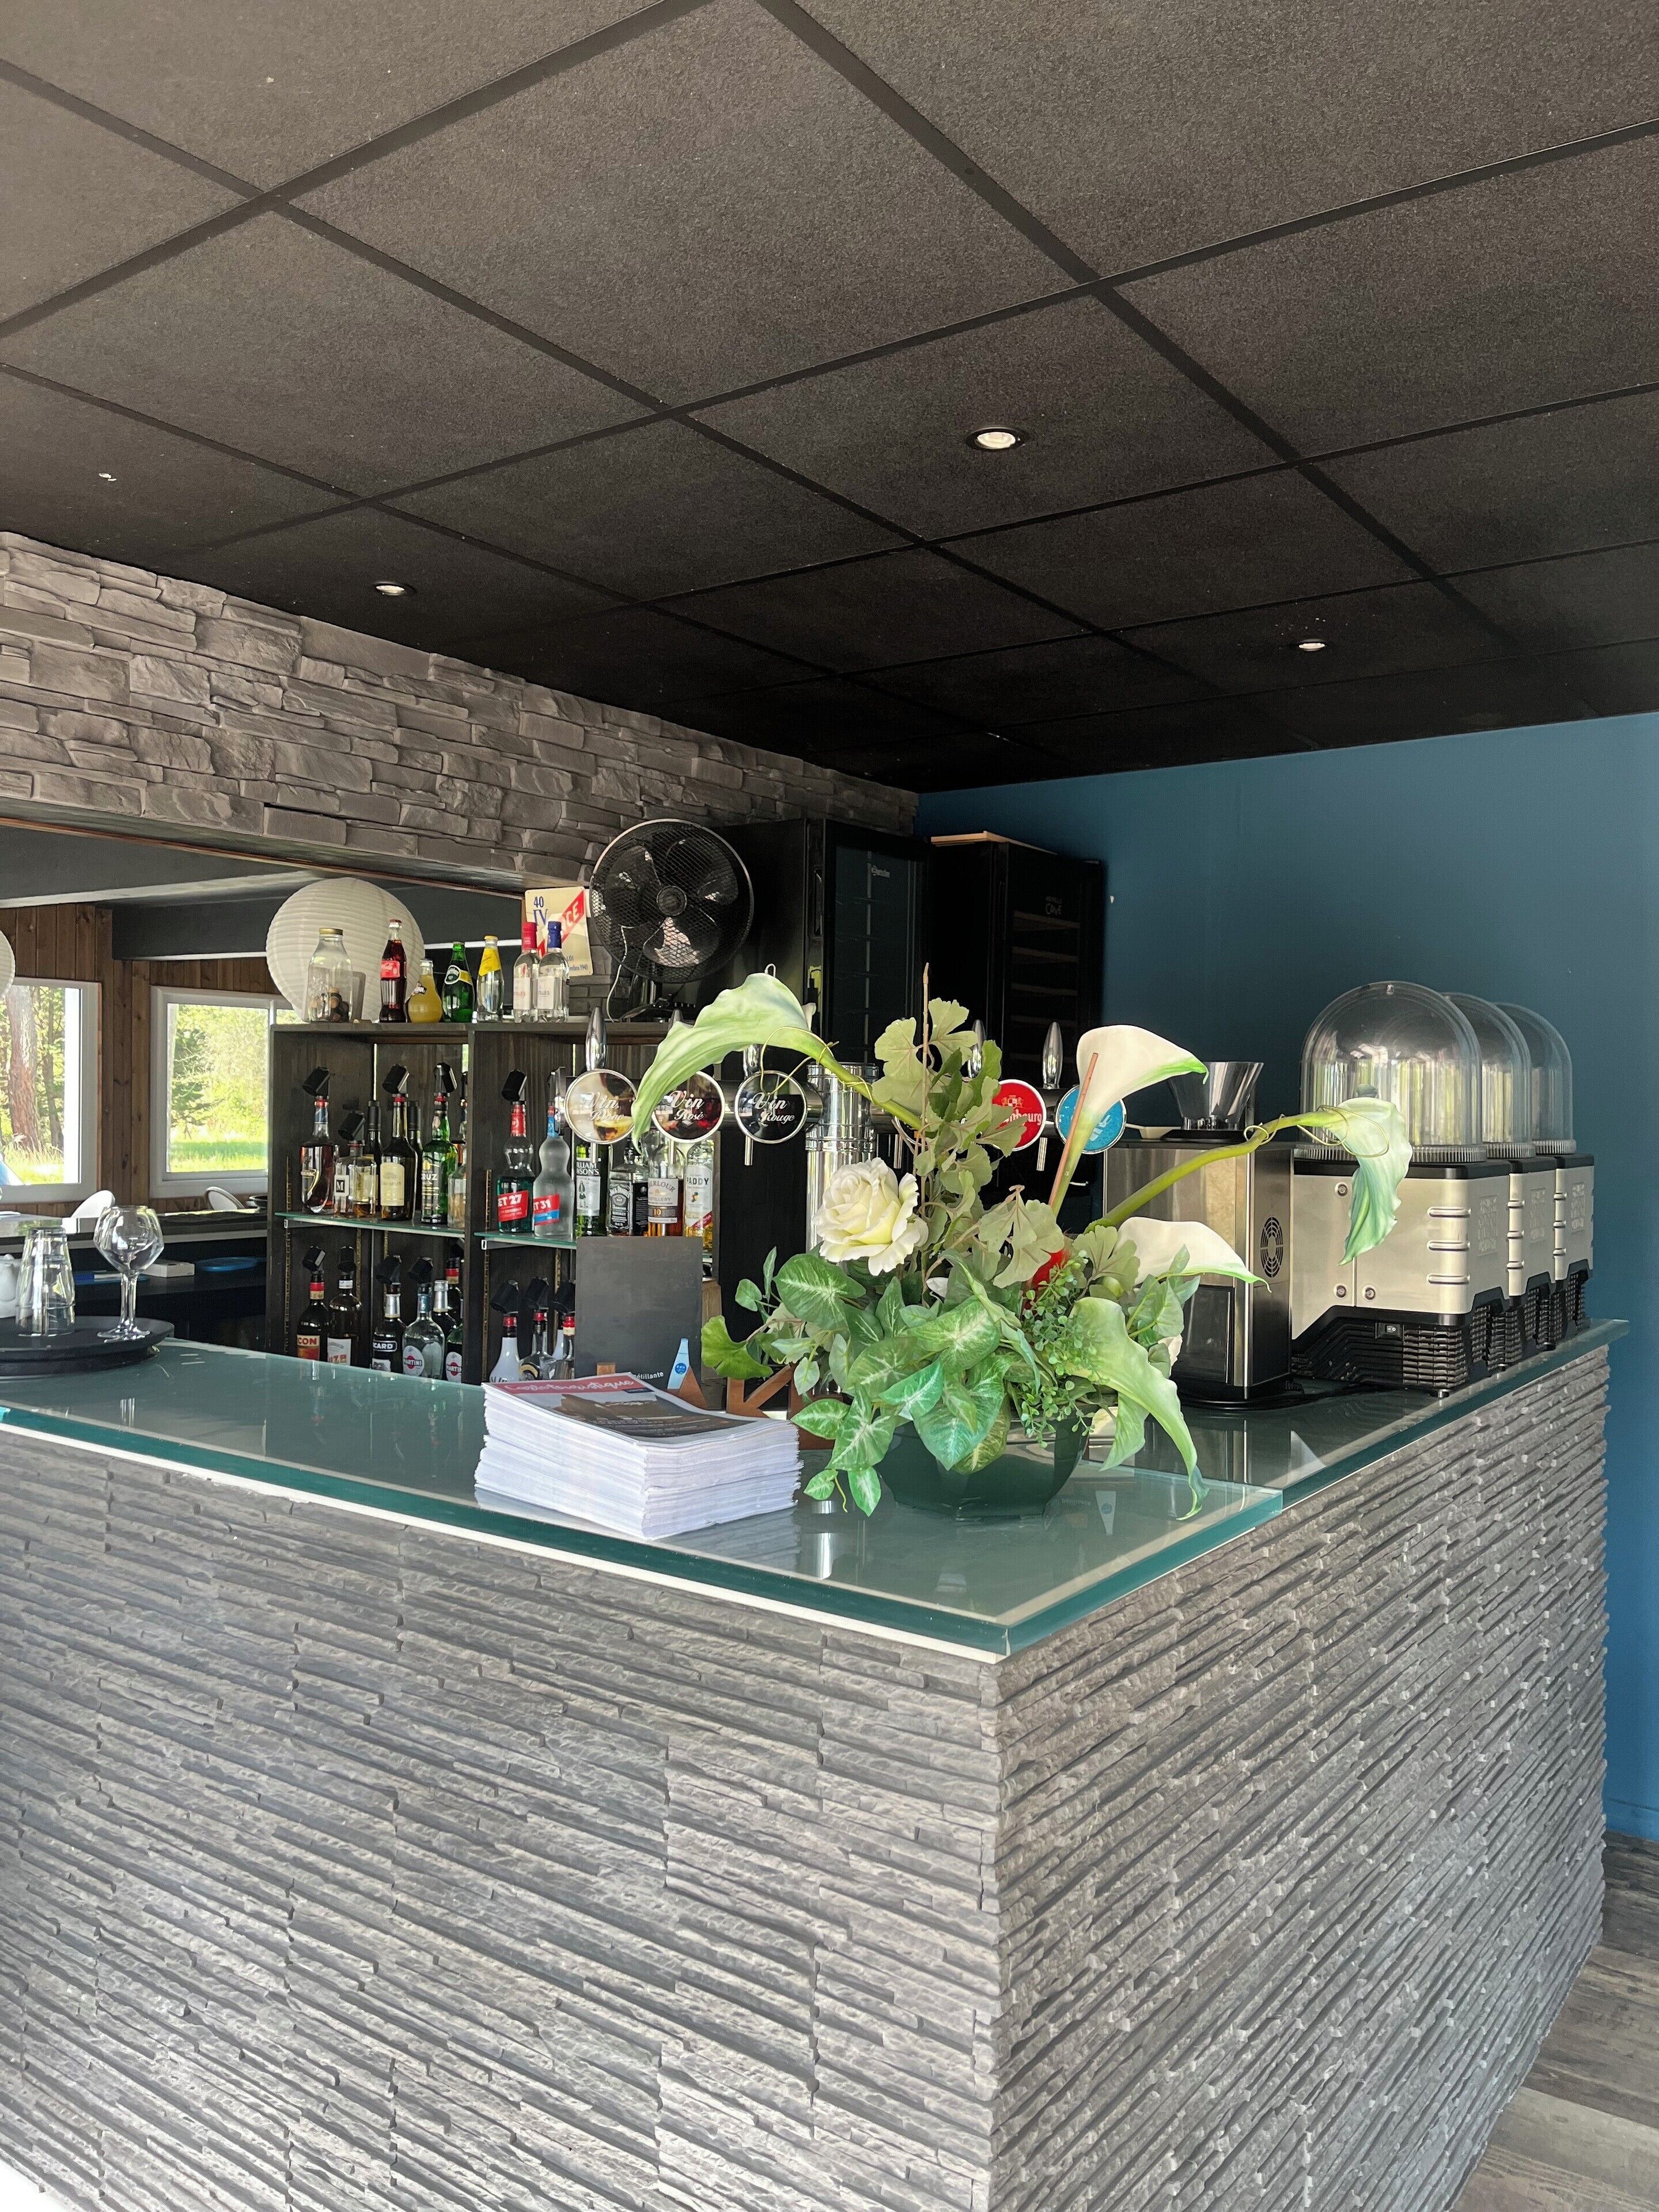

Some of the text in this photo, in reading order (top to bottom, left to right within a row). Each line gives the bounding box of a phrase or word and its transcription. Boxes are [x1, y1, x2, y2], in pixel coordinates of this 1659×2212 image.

[533, 896, 544, 908] 40
[585, 1092, 619, 1109] Vin
[668, 1090, 704, 1108] Vin
[751, 1092, 788, 1109] Vin
[673, 1108, 704, 1121] Rosé
[759, 1110, 795, 1125] Rouge
[686, 1176, 710, 1185] PADDY
[509, 1194, 522, 1205] 27
[540, 1199, 551, 1210] 31
[653, 1208, 661, 1217] 10
